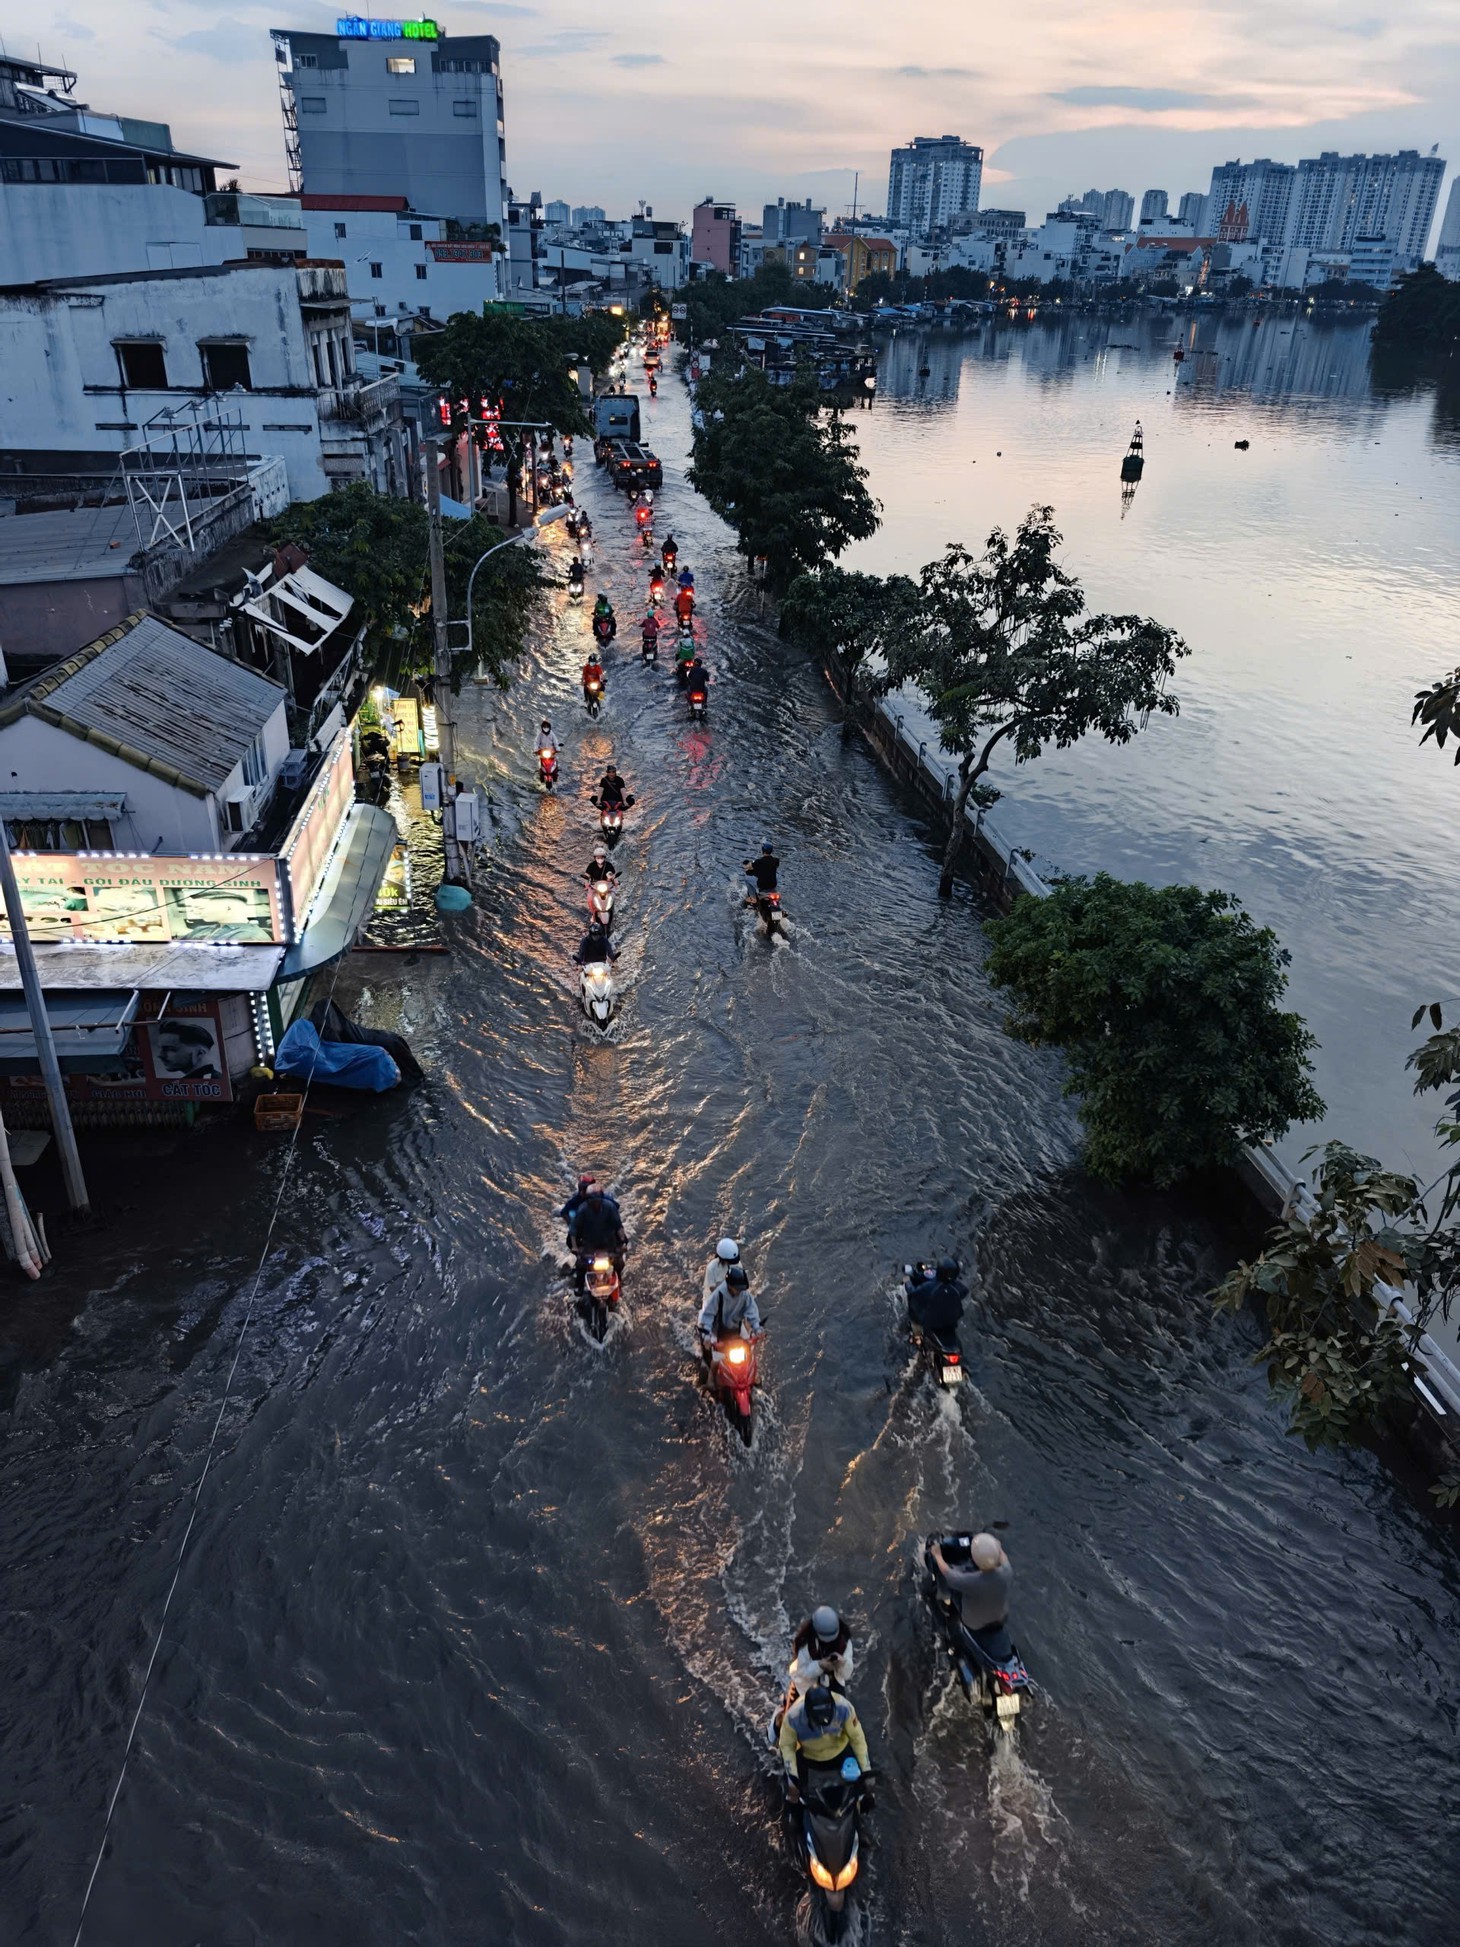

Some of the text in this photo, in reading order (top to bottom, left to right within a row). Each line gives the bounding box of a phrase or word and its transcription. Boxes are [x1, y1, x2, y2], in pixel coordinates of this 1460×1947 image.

[337, 18, 437, 38] NGÂN GIANG HOTEL
[167, 863, 249, 875] NAM
[192, 1081, 222, 1097] TÓC
